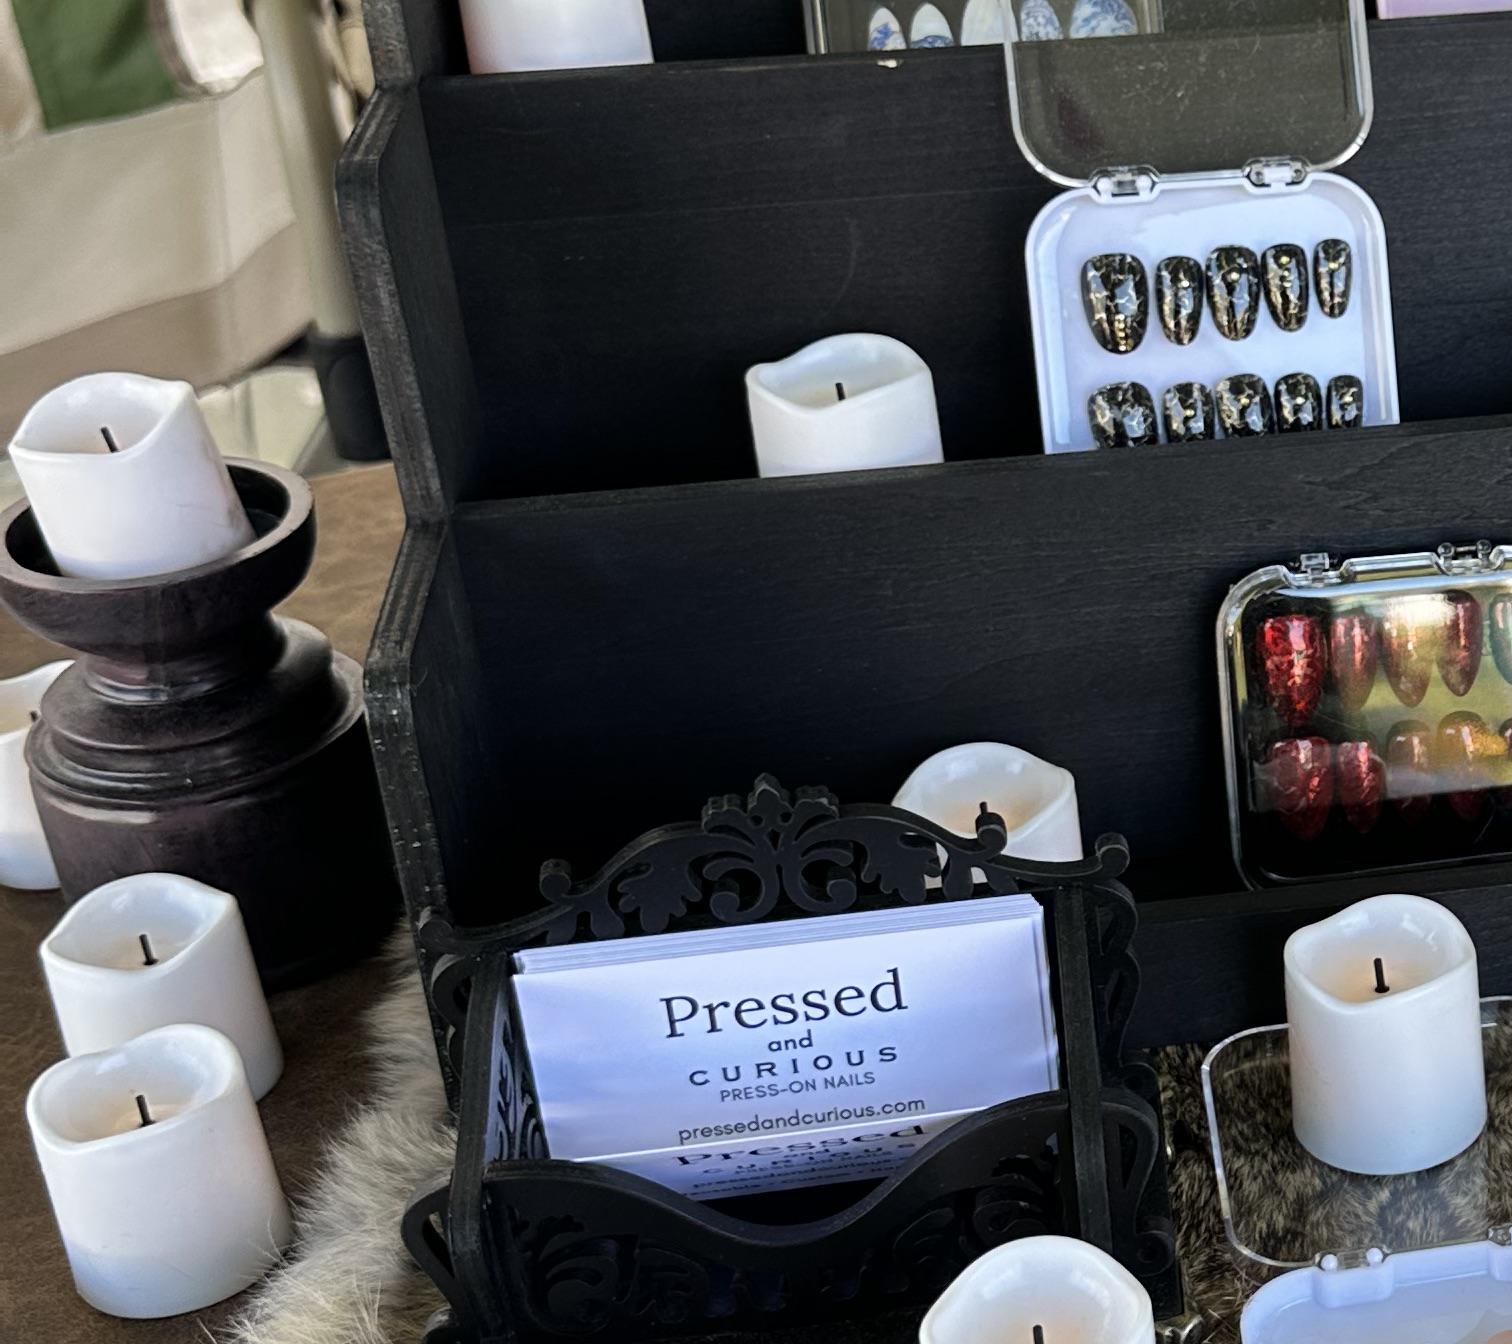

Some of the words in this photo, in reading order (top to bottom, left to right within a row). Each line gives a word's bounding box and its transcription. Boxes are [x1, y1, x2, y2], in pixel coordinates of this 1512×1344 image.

[659, 967, 909, 1039] Pressed
[767, 1029, 814, 1052] and
[688, 1046, 898, 1086] CURIOUS
[719, 1078, 817, 1102] PRESS-ON
[824, 1071, 876, 1090] NAILS
[678, 1098, 926, 1145] pressedandcurious.com
